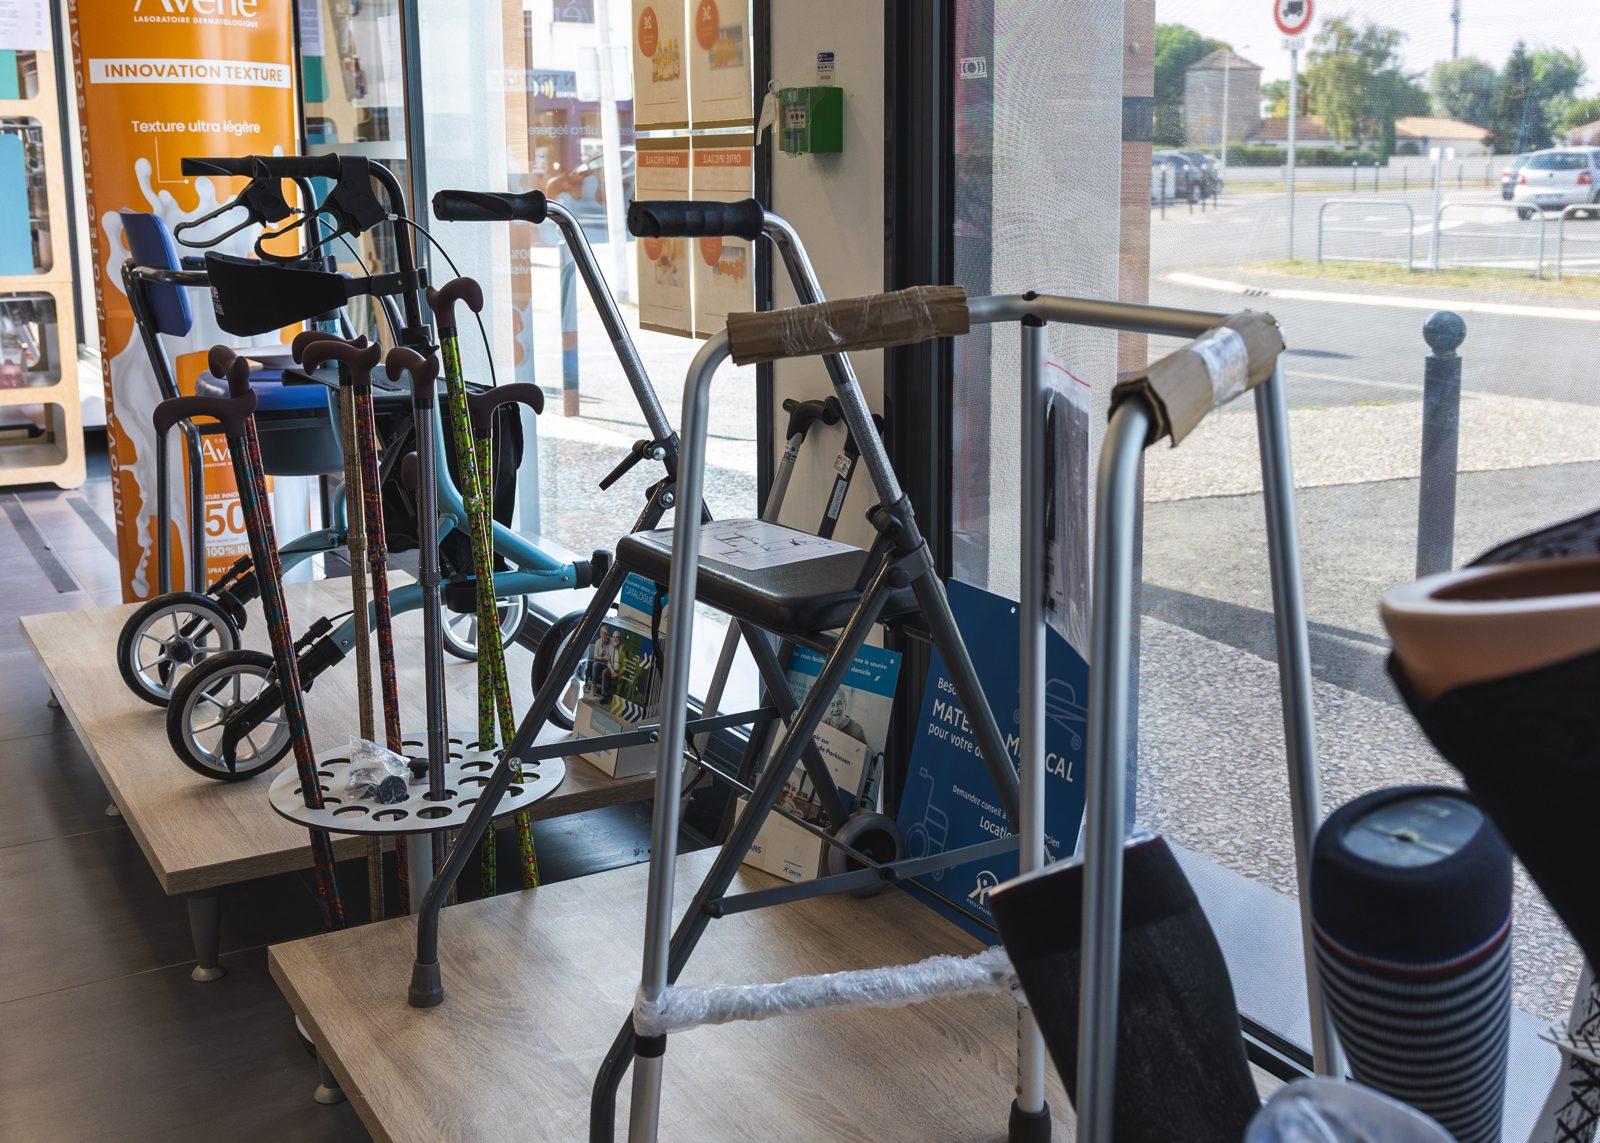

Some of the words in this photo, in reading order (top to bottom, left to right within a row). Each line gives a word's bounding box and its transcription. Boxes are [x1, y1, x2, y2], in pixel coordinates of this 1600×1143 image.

[134, 16, 190, 24] LABORATOIRE
[193, 18, 259, 28] DERMATOLOGIQUE
[68, 0, 86, 108] SOLAIR
[104, 64, 221, 79] INNOVATION
[224, 66, 283, 82] TEXTURE
[132, 120, 186, 132] Texture
[188, 120, 220, 133] ultra
[224, 121, 261, 136] légère
[80, 126, 107, 320] PROTECTION
[98, 336, 124, 528] INNOVATION
[932, 698, 974, 734] MATE
[928, 722, 948, 740] pour
[950, 733, 973, 753] votre
[826, 748, 851, 766] Parkinson
[952, 784, 981, 806] Demandez
[981, 801, 1002, 818] conseil
